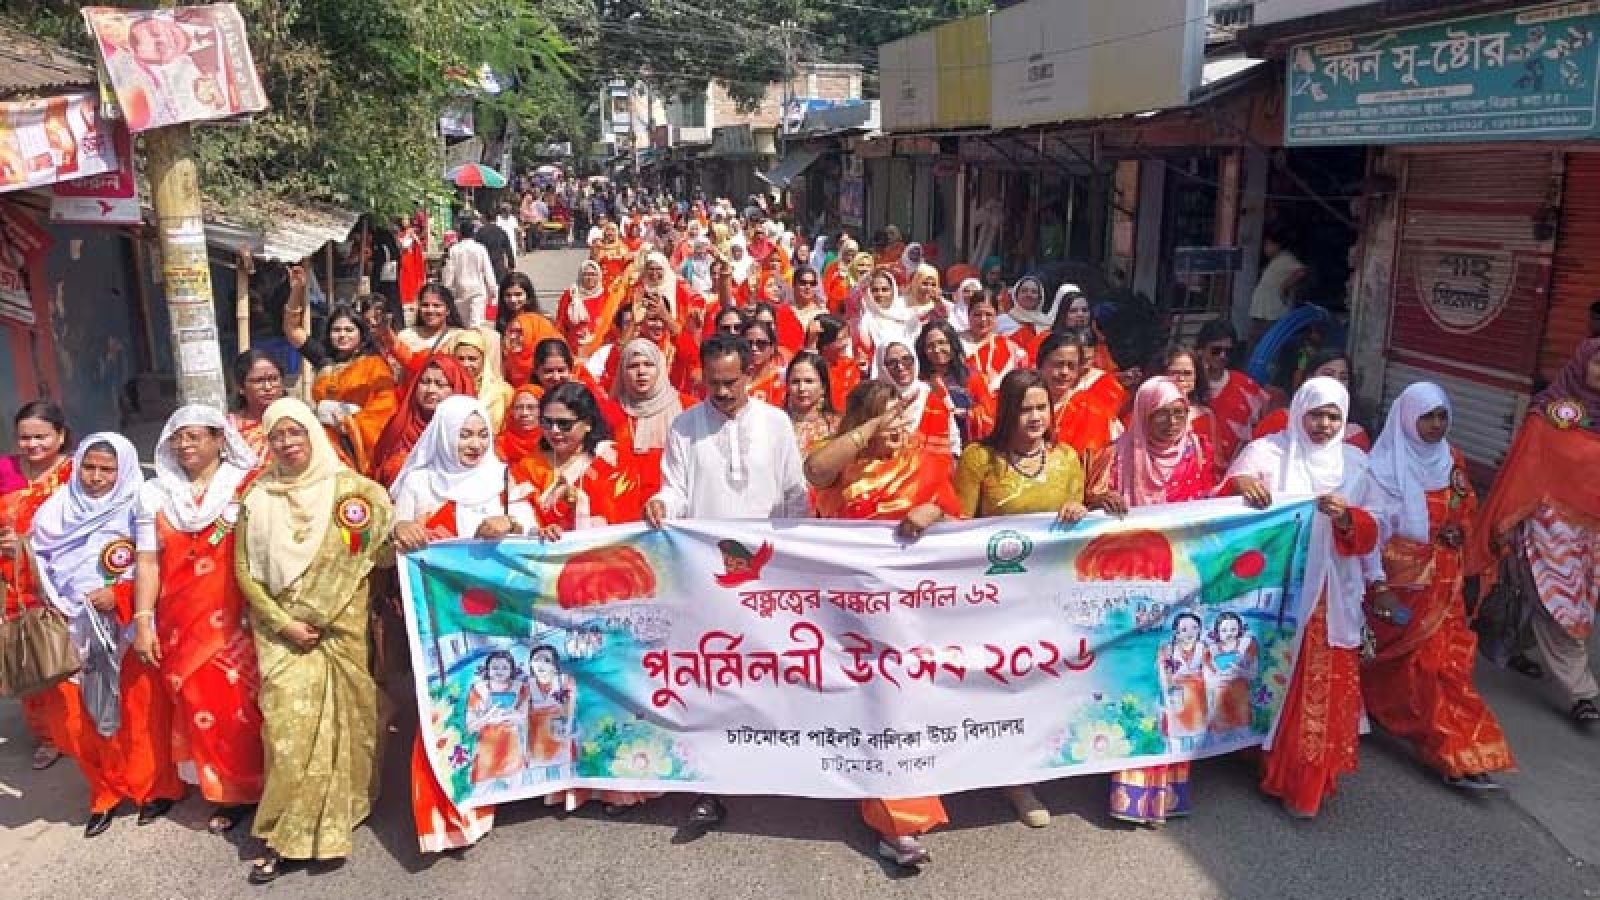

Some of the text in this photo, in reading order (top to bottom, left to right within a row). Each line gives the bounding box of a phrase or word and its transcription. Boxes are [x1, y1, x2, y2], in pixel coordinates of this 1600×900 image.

[828, 589, 891, 614] বন্ধনে
[964, 583, 999, 605] ৬২
[642, 621, 824, 712] পুনর্মিলনী
[726, 717, 1025, 750] চাটমোহর পাইলট বালিকা উচ্চ বিদ্যালয়
